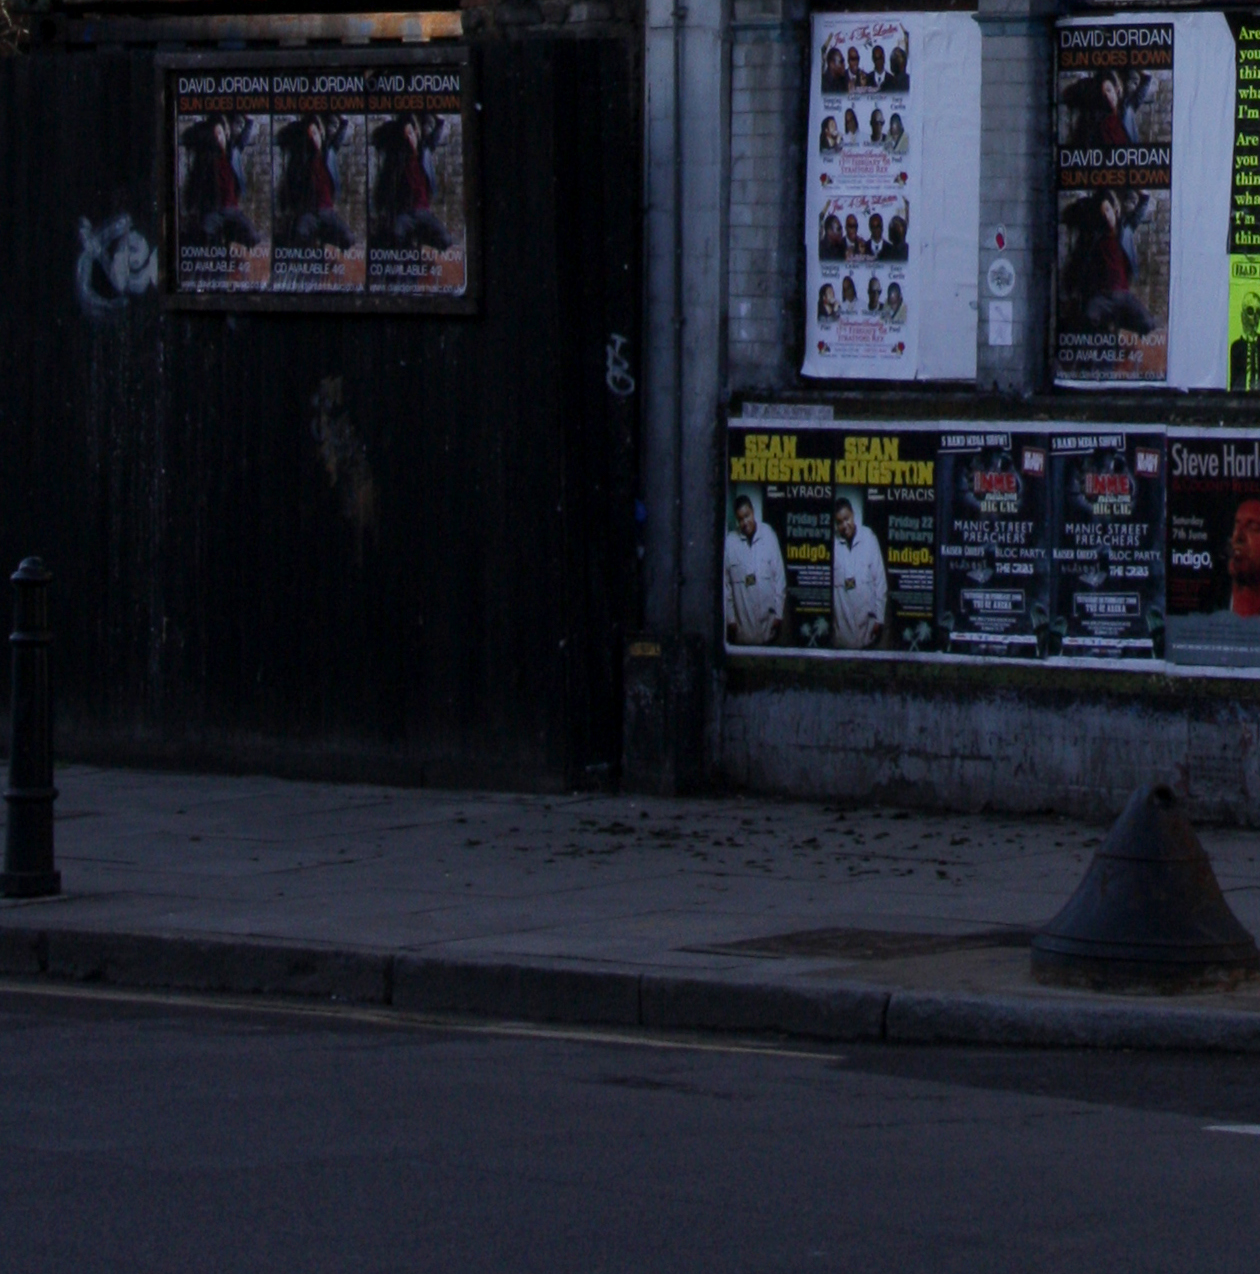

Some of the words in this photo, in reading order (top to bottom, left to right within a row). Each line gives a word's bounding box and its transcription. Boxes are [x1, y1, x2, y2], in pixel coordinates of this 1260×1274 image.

[1060, 29, 1104, 48] DAVID
[1107, 28, 1172, 47] JORDAN
[1061, 51, 1088, 66] SUN
[1091, 50, 1127, 65] GOES
[1131, 49, 1171, 64] DOWN
[179, 76, 215, 93] DAVID
[218, 76, 269, 93] JORDAN
[273, 76, 309, 93] DAVID
[312, 76, 364, 93] JORDAN
[408, 74, 460, 92] JORDAN
[180, 95, 202, 111] SUN
[204, 95, 233, 111] GOES
[236, 95, 270, 111] DOWN
[274, 95, 297, 111] SUN
[299, 95, 328, 111] GOES
[330, 95, 365, 111] DOWN
[368, 95, 391, 111] SUN
[394, 95, 424, 111] GOES
[426, 94, 460, 110] DOWN
[1238, 105, 1259, 119] I'm
[1236, 132, 1259, 146] Are
[1060, 149, 1102, 167] DAVID
[1106, 148, 1170, 166] JORDAN
[1236, 154, 1258, 168] you
[1061, 170, 1088, 185] SUN
[1090, 169, 1126, 185] GOES
[1129, 169, 1169, 184] DOWN
[180, 246, 227, 258] DOWNLOAD
[275, 247, 322, 259] DOWNLOAD
[370, 249, 419, 261] DOWNLOAD
[181, 260, 193, 272] CD
[194, 260, 236, 272] AVAILABLE
[274, 262, 287, 274] CD
[288, 263, 330, 274] AVAILABLE
[369, 264, 383, 275] CD
[384, 264, 428, 276] AVAILABLE
[1059, 333, 1116, 346] DOWNLOAD
[1118, 333, 1139, 346] OUT
[1141, 333, 1166, 346] NOW
[1059, 349, 1073, 361] CD
[1076, 349, 1125, 362] AVAILABLE
[744, 434, 797, 459] SEAN
[844, 436, 899, 461] SEAN
[1171, 442, 1219, 477] Steve
[731, 456, 831, 482] KINGSTON
[835, 459, 934, 485] KINGSTON
[981, 472, 1016, 492] NME
[1094, 473, 1129, 494] NME
[786, 485, 832, 499] LYRACIS
[887, 488, 934, 501] LYRACIS
[786, 512, 818, 526] Friday
[888, 515, 919, 530] Friday
[921, 516, 933, 529] 22
[954, 520, 990, 532] MANIC
[994, 521, 1033, 533] STREET
[1065, 523, 1102, 534] MANIC
[1108, 523, 1148, 535] STREET
[888, 530, 934, 544] February
[963, 532, 1026, 544] PREACHERS
[1076, 534, 1139, 546] PREACHERS
[1172, 528, 1187, 540] 7th
[1189, 529, 1208, 540] June
[994, 546, 1018, 558] BLOC
[1020, 547, 1045, 559] PARTY
[1108, 550, 1132, 561] BLOC
[1134, 550, 1160, 561] PARTY
[995, 562, 1011, 574] THE
[1109, 565, 1124, 576] THE
